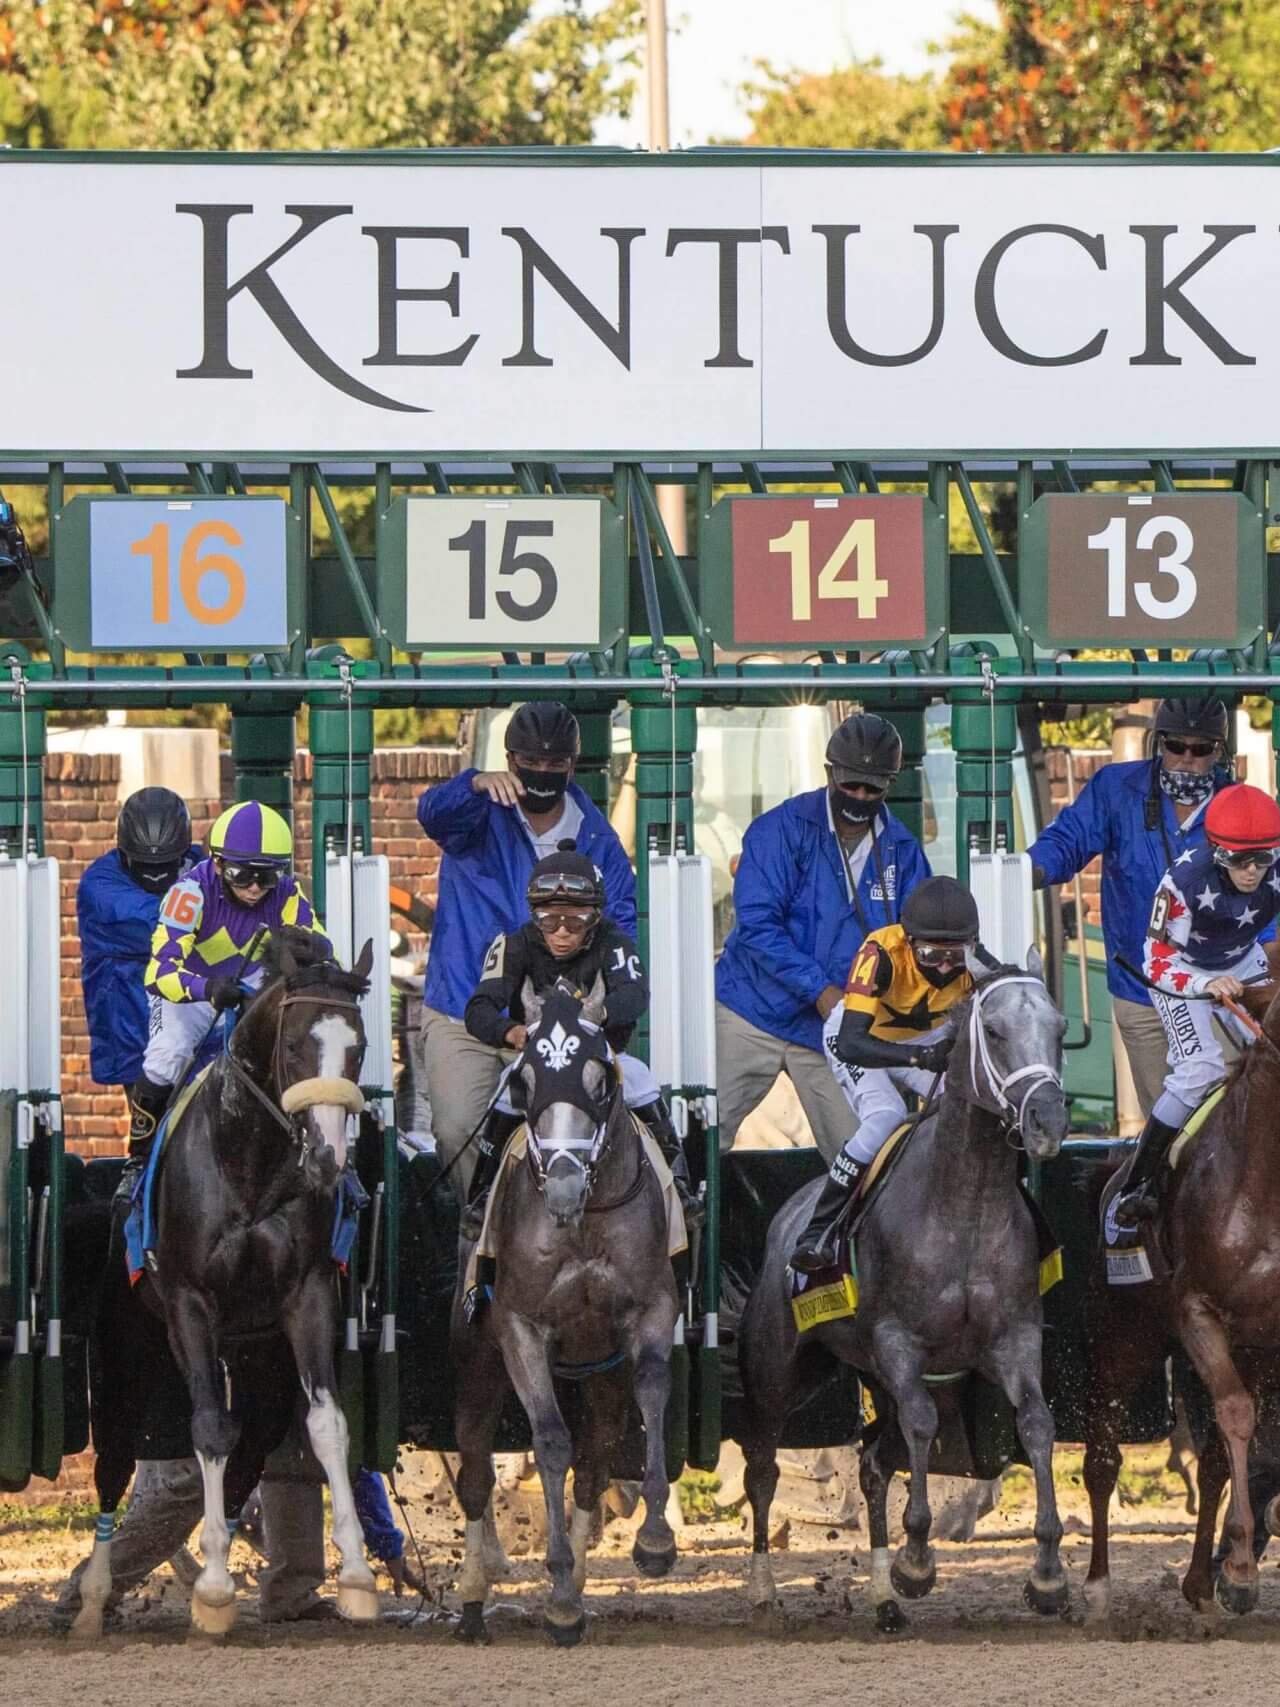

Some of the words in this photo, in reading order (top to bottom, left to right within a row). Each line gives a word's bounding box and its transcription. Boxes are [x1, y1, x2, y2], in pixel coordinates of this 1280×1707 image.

[132, 521, 246, 625] 16
[449, 519, 558, 622] 15
[769, 519, 889, 620] 14
[1088, 515, 1198, 620] 13
[164, 887, 201, 925] 16
[851, 952, 877, 986] 14
[1171, 1001, 1203, 1057] RUBY'S
